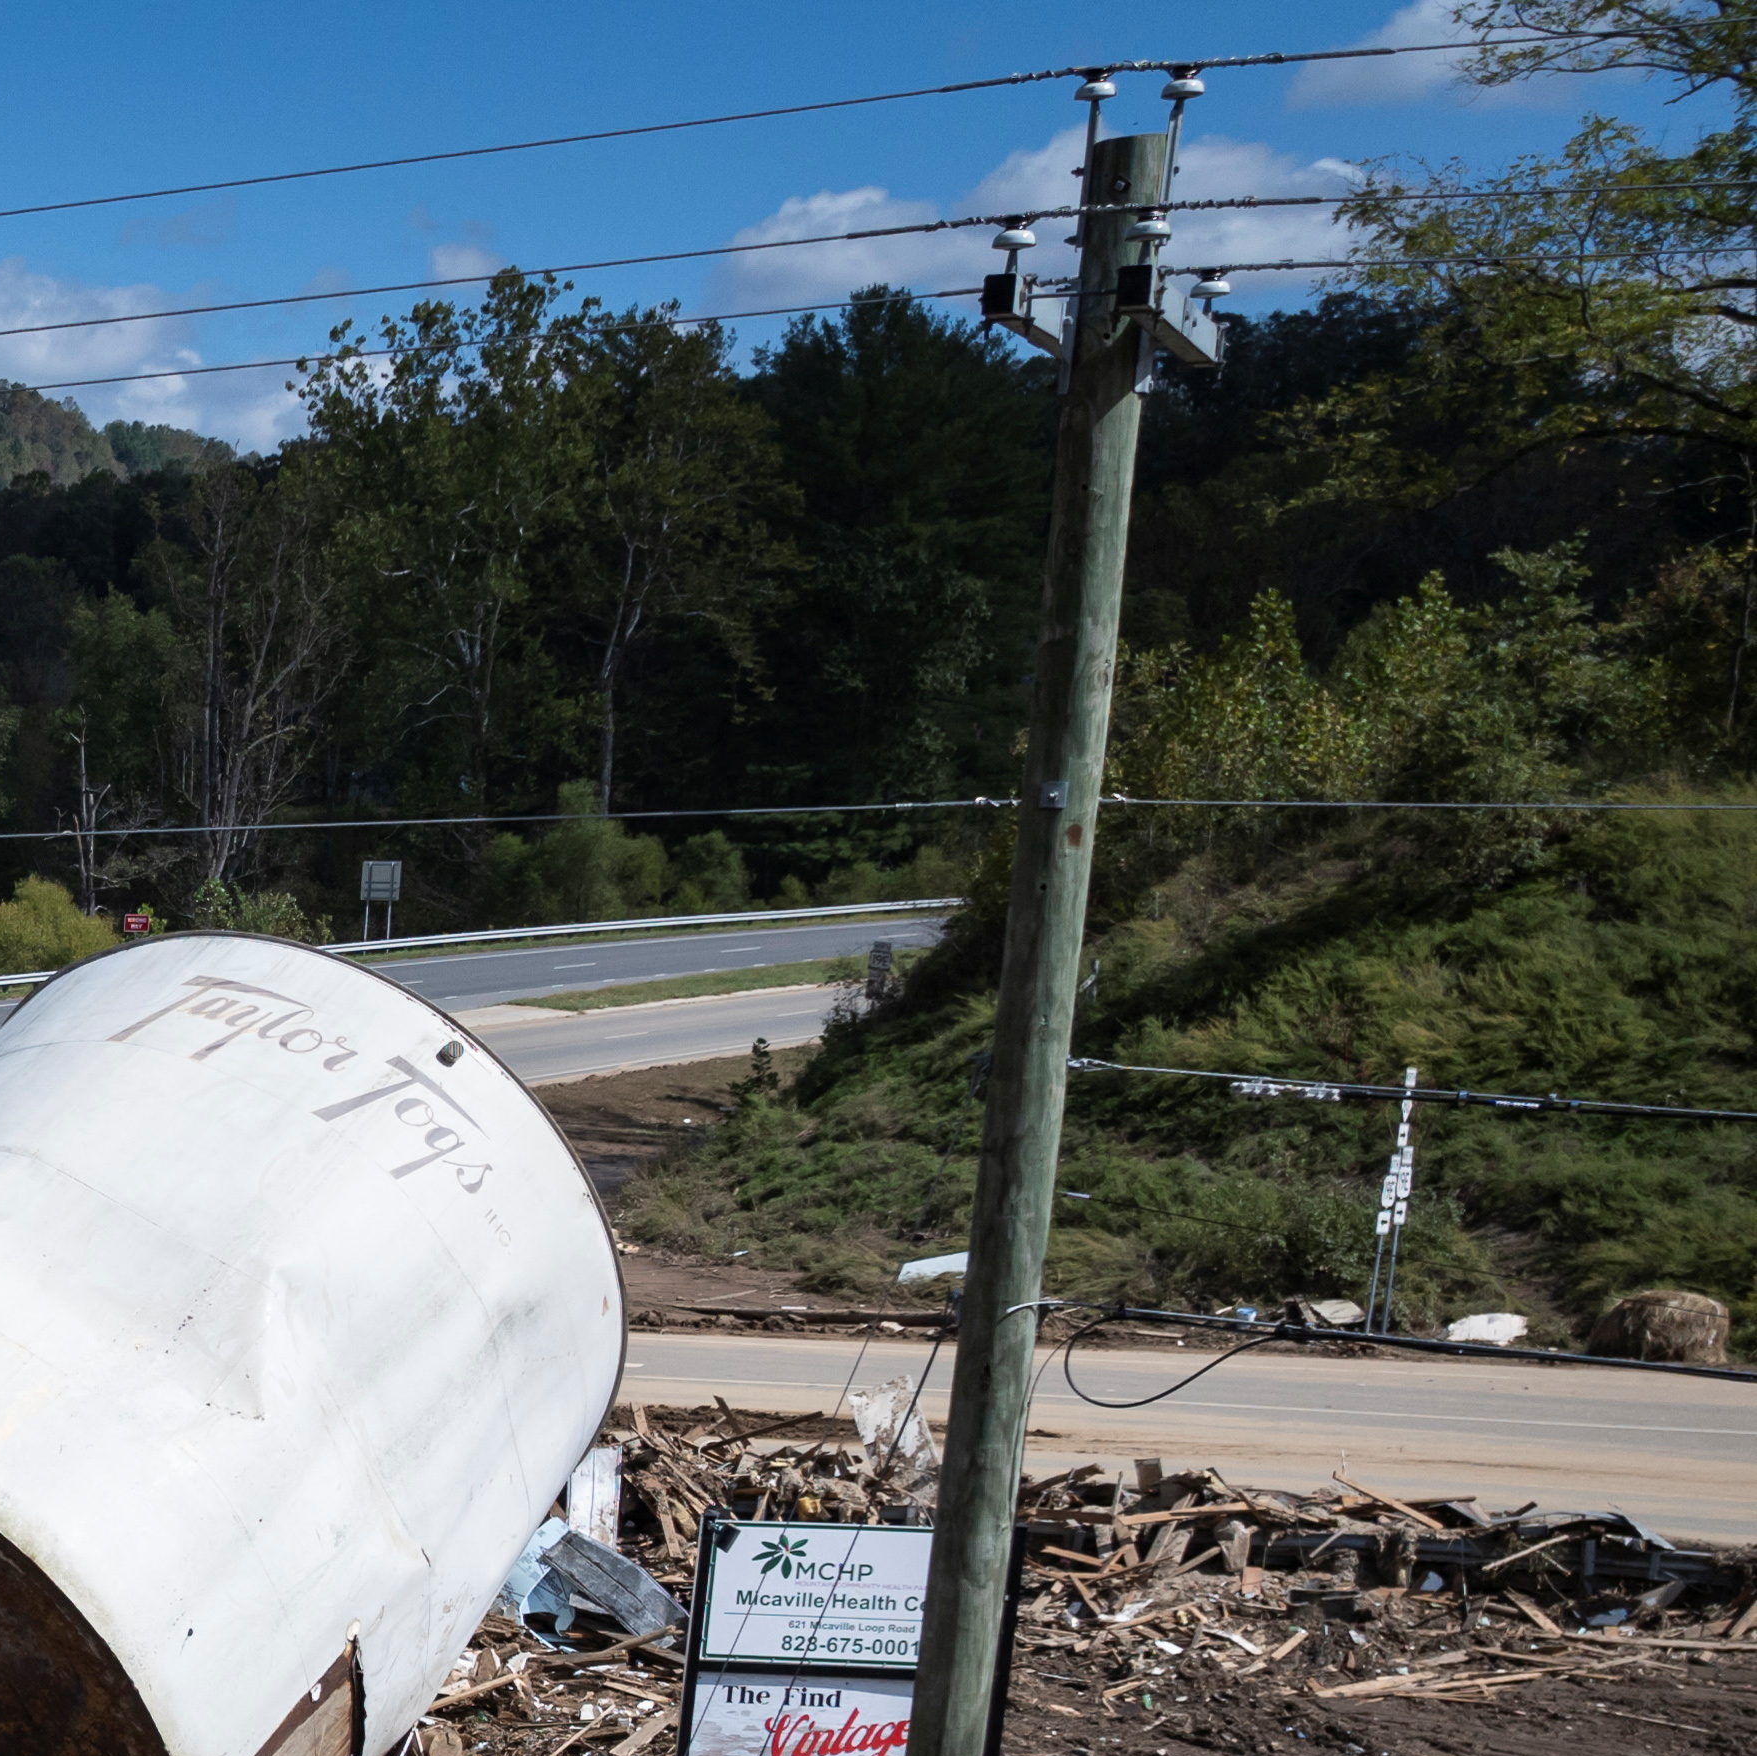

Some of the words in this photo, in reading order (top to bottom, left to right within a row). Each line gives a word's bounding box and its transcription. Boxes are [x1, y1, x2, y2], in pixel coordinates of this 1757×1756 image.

[104, 975, 358, 1071] Taylor
[311, 1055, 493, 1194] Togs
[795, 1562, 874, 1581] MCHP
[736, 1590, 825, 1609] Micaville
[831, 1593, 897, 1611] Health
[788, 1620, 806, 1629] 621
[809, 1621, 855, 1631] Micaville
[858, 1622, 886, 1634] Loop
[888, 1624, 916, 1634] Road
[781, 1635, 919, 1656] 828-675-0001
[722, 1685, 770, 1704] The
[783, 1687, 842, 1708] Find
